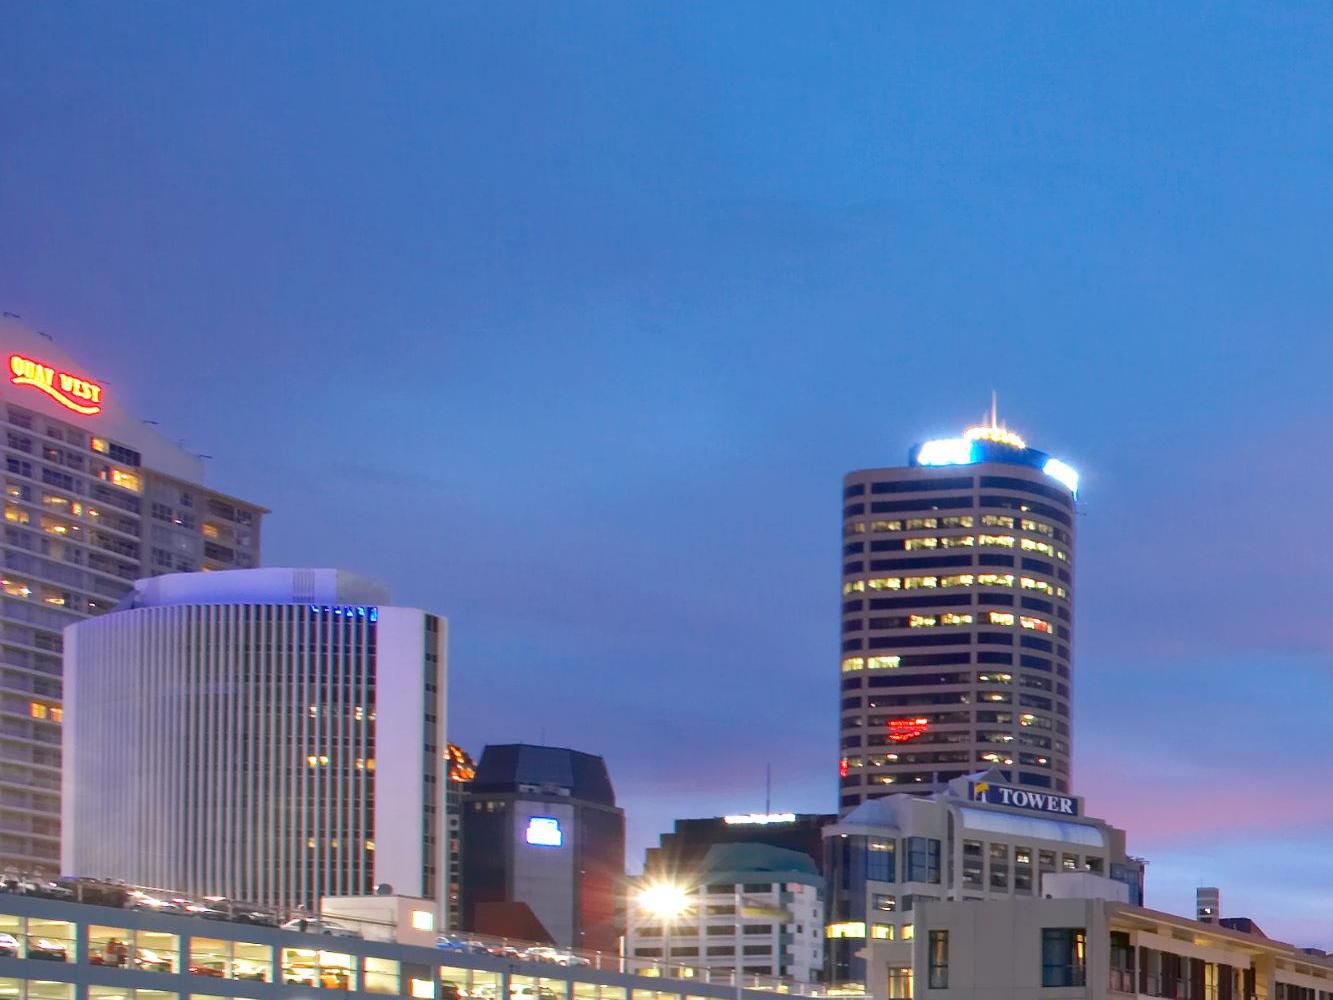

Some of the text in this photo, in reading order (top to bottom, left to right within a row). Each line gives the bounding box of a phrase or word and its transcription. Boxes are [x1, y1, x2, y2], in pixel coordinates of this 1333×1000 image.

[10, 355, 101, 402] QUAY WEST
[999, 787, 1073, 814] TOWER
